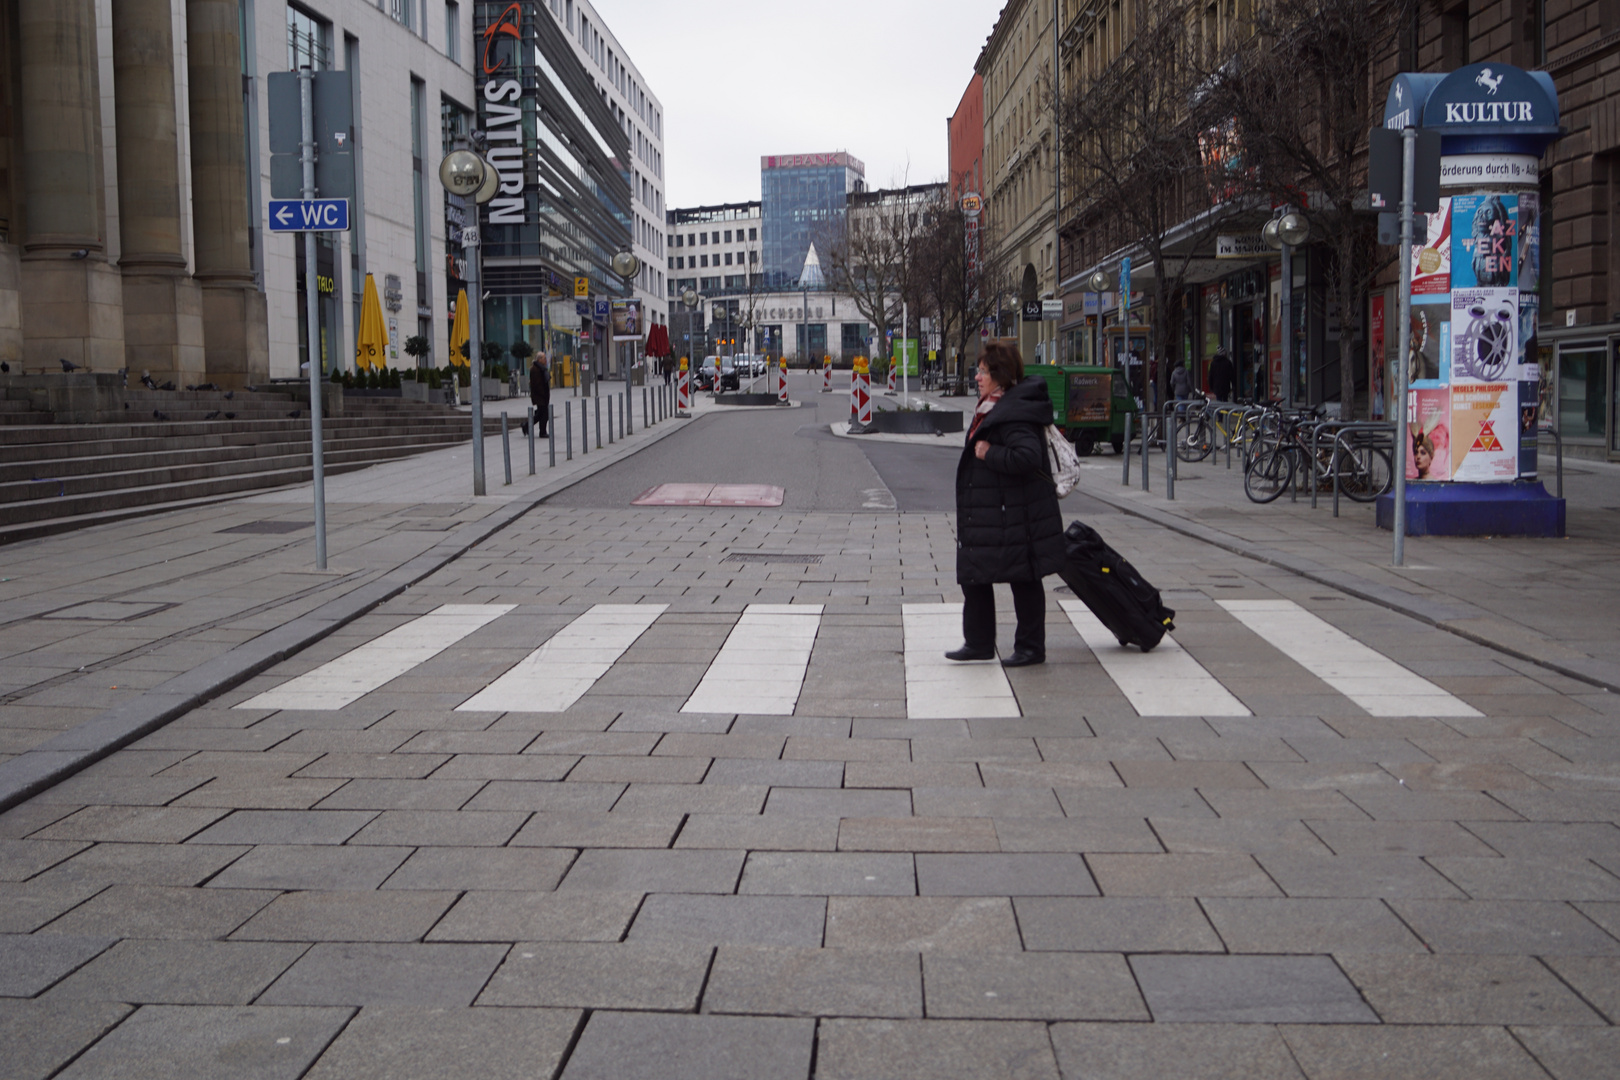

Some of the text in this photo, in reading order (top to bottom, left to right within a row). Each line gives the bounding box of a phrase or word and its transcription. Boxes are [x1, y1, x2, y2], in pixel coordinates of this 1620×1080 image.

[1445, 101, 1534, 123] KULTUR
[484, 79, 525, 224] SATURN
[779, 153, 838, 167] L-BANK
[1485, 163, 1509, 175] durch
[300, 203, 338, 226] WC
[1489, 219, 1516, 236] AZ
[463, 231, 478, 242] 48
[1461, 238, 1505, 254] TEK
[1485, 255, 1512, 273] EN
[1073, 376, 1098, 385] Radwerk
